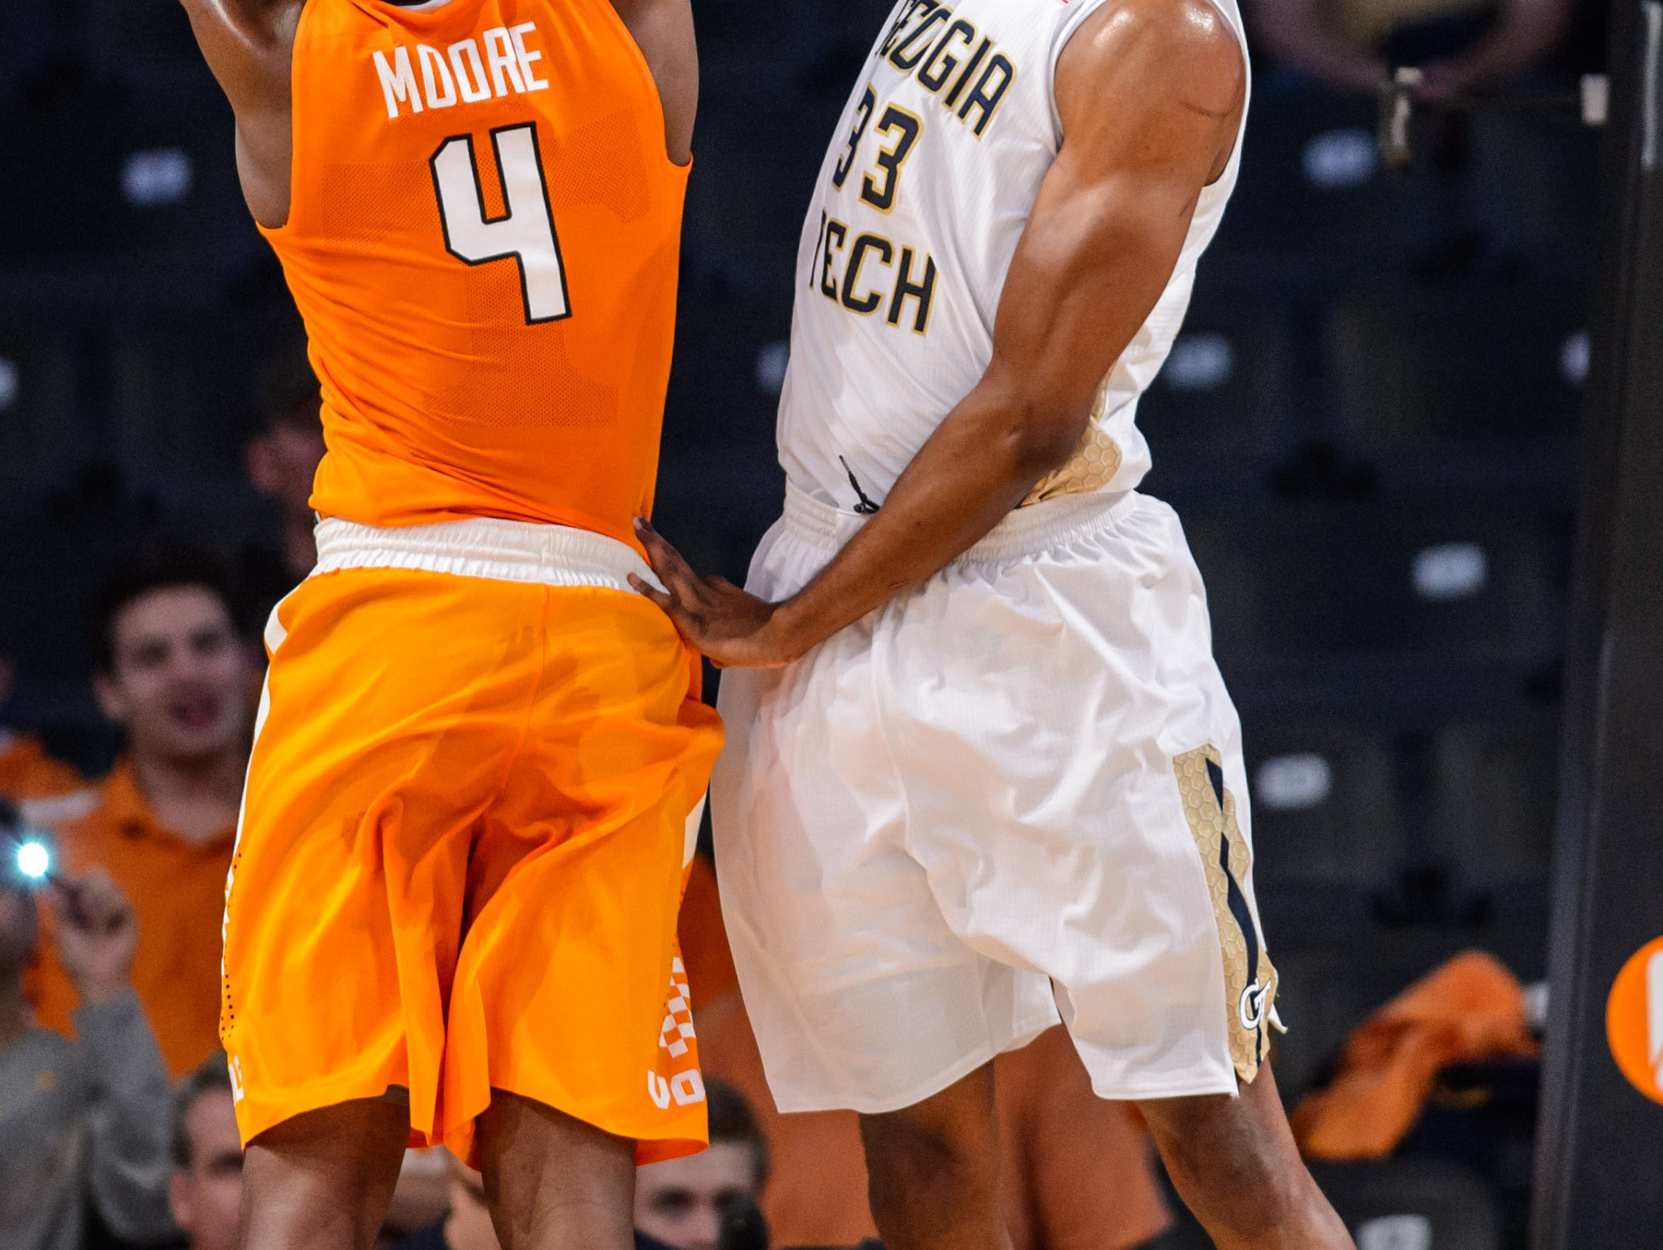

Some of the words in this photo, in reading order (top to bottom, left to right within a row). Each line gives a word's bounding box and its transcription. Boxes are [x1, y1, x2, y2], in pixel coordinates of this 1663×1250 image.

[372, 21, 549, 119] MOORE
[832, 82, 924, 215] 33
[428, 121, 572, 325] 4
